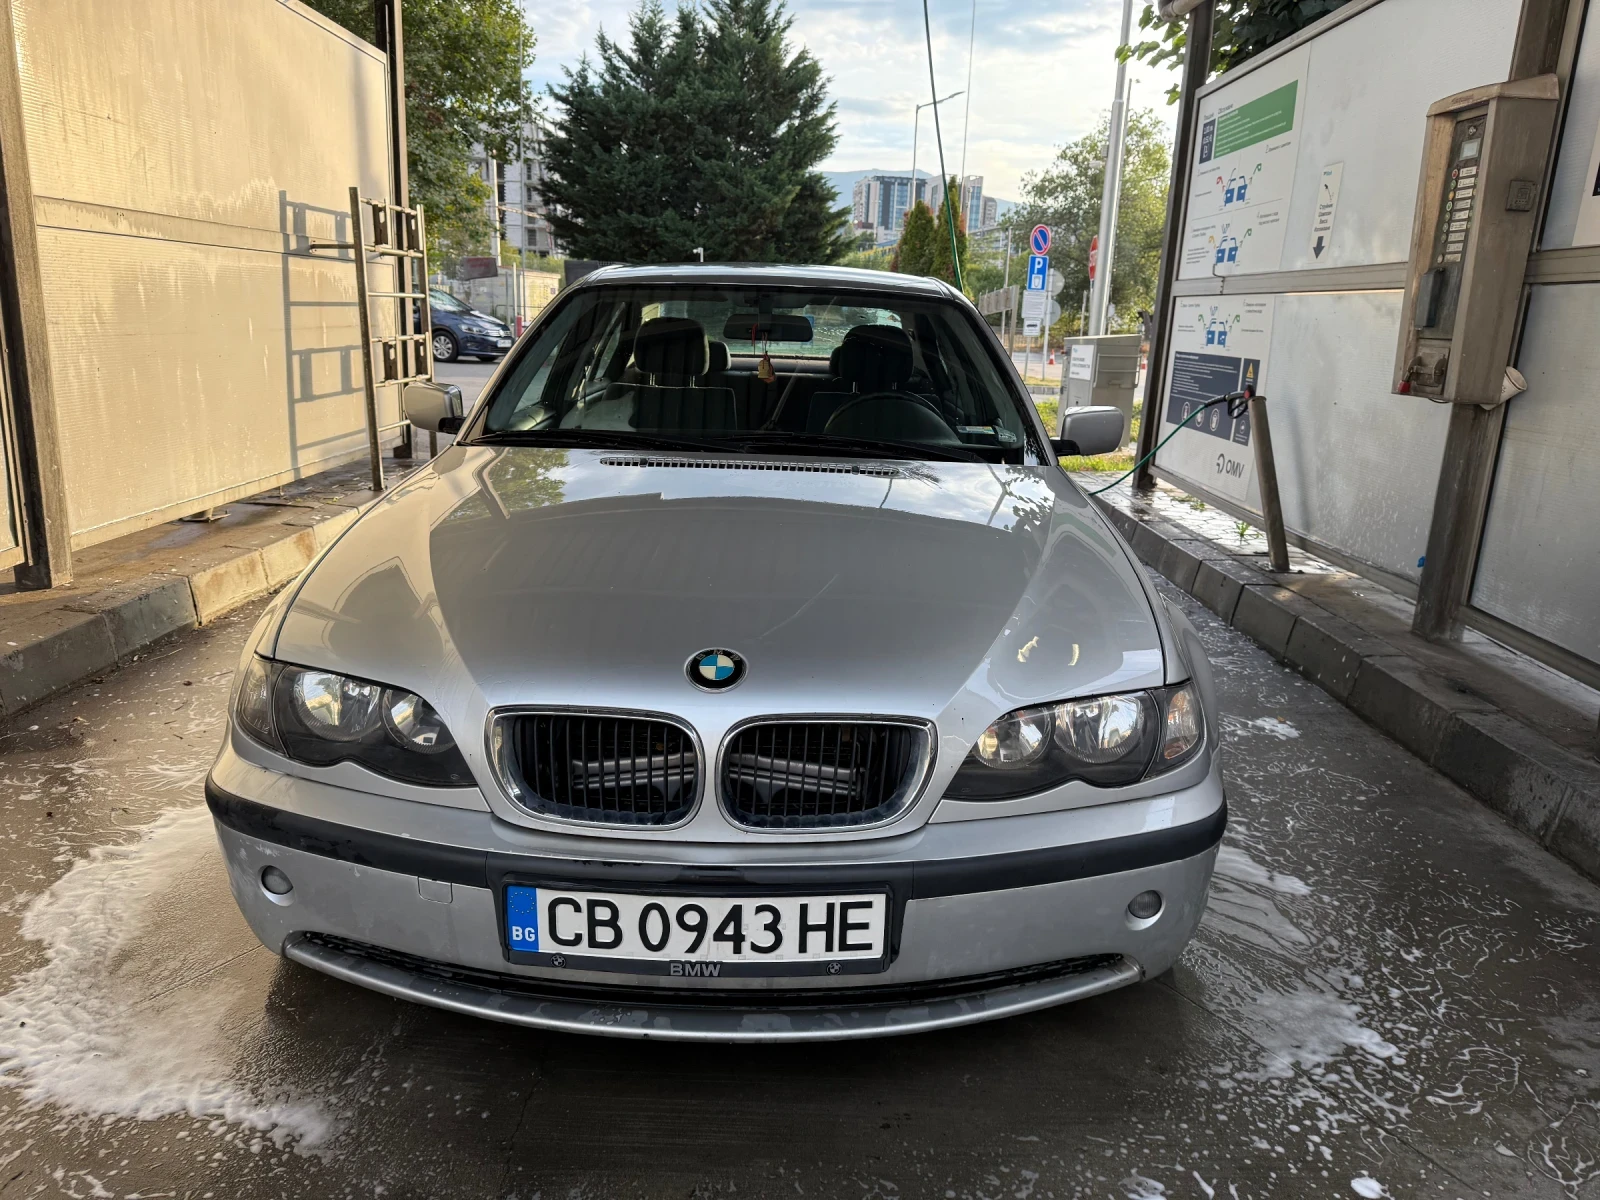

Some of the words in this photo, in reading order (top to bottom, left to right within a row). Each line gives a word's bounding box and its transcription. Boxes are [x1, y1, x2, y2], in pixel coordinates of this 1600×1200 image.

[1034, 258, 1044, 274] P
[1226, 459, 1245, 478] OMV
[548, 896, 623, 950] CB
[638, 902, 783, 954] 0943
[798, 900, 873, 954] HE
[512, 926, 536, 942] BG
[670, 962, 721, 978] BMW
